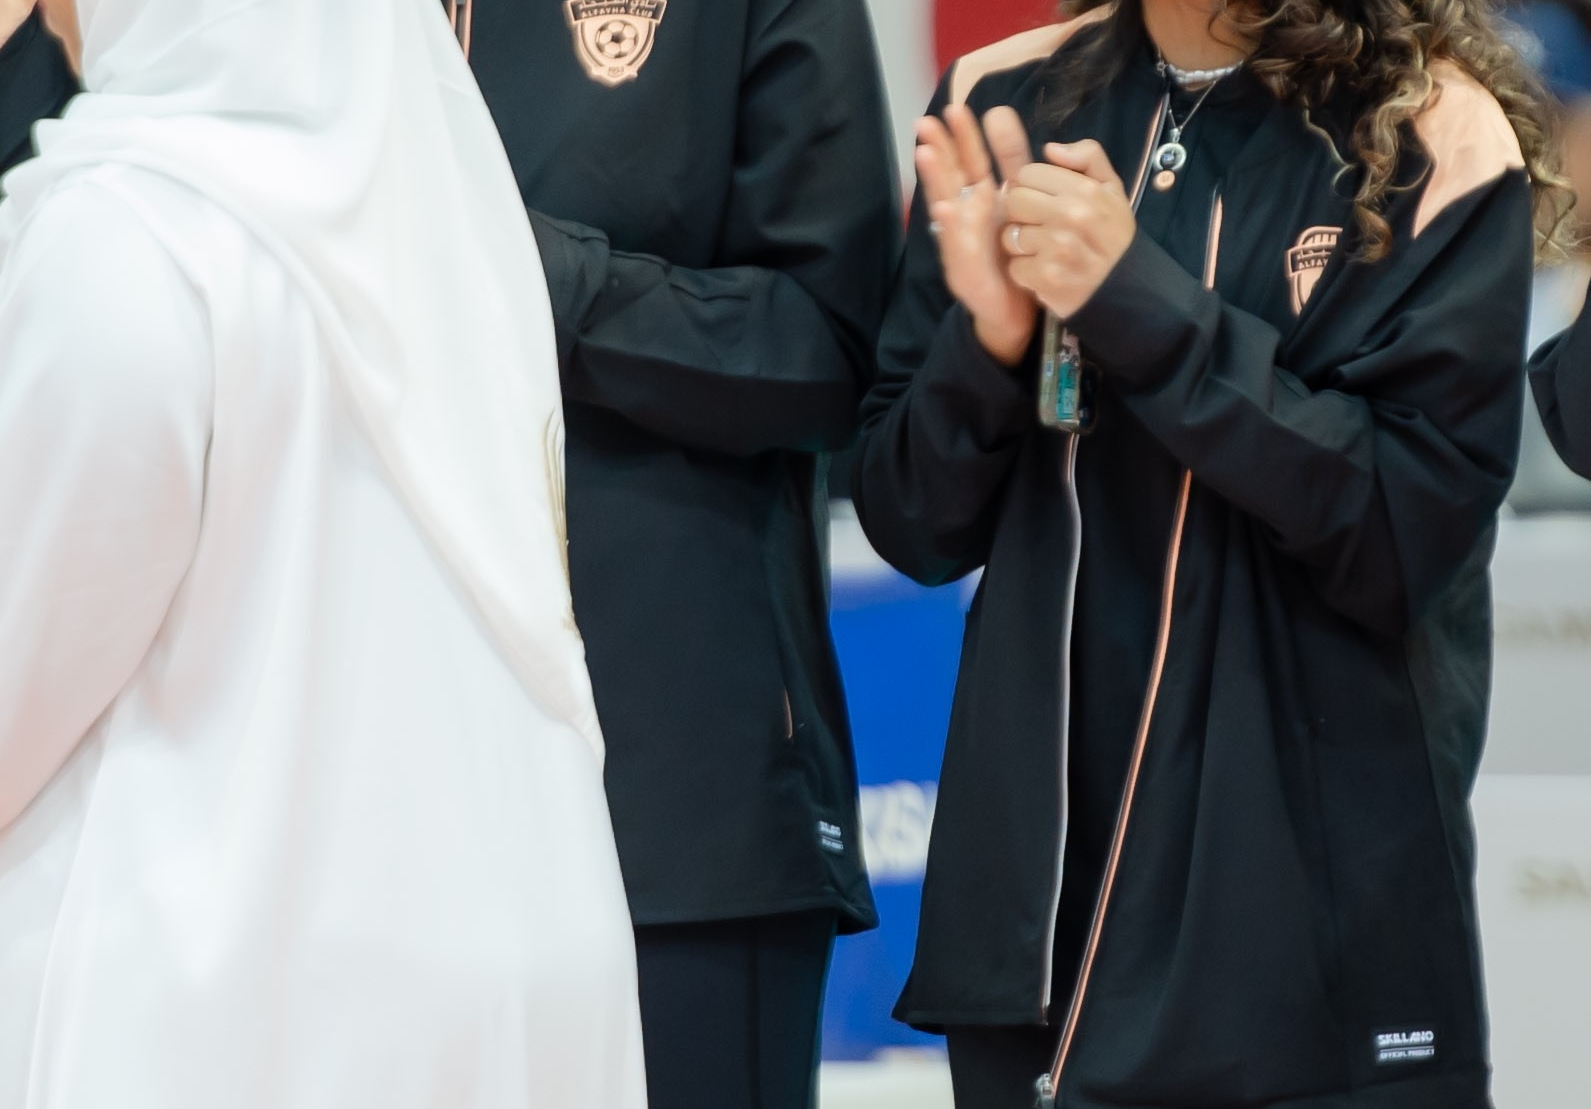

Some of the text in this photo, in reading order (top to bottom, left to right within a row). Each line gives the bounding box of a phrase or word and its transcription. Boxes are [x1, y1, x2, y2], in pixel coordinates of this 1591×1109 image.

[581, 6, 654, 18] ALFAYHA CLUB
[1298, 257, 1329, 270] ALFAY
